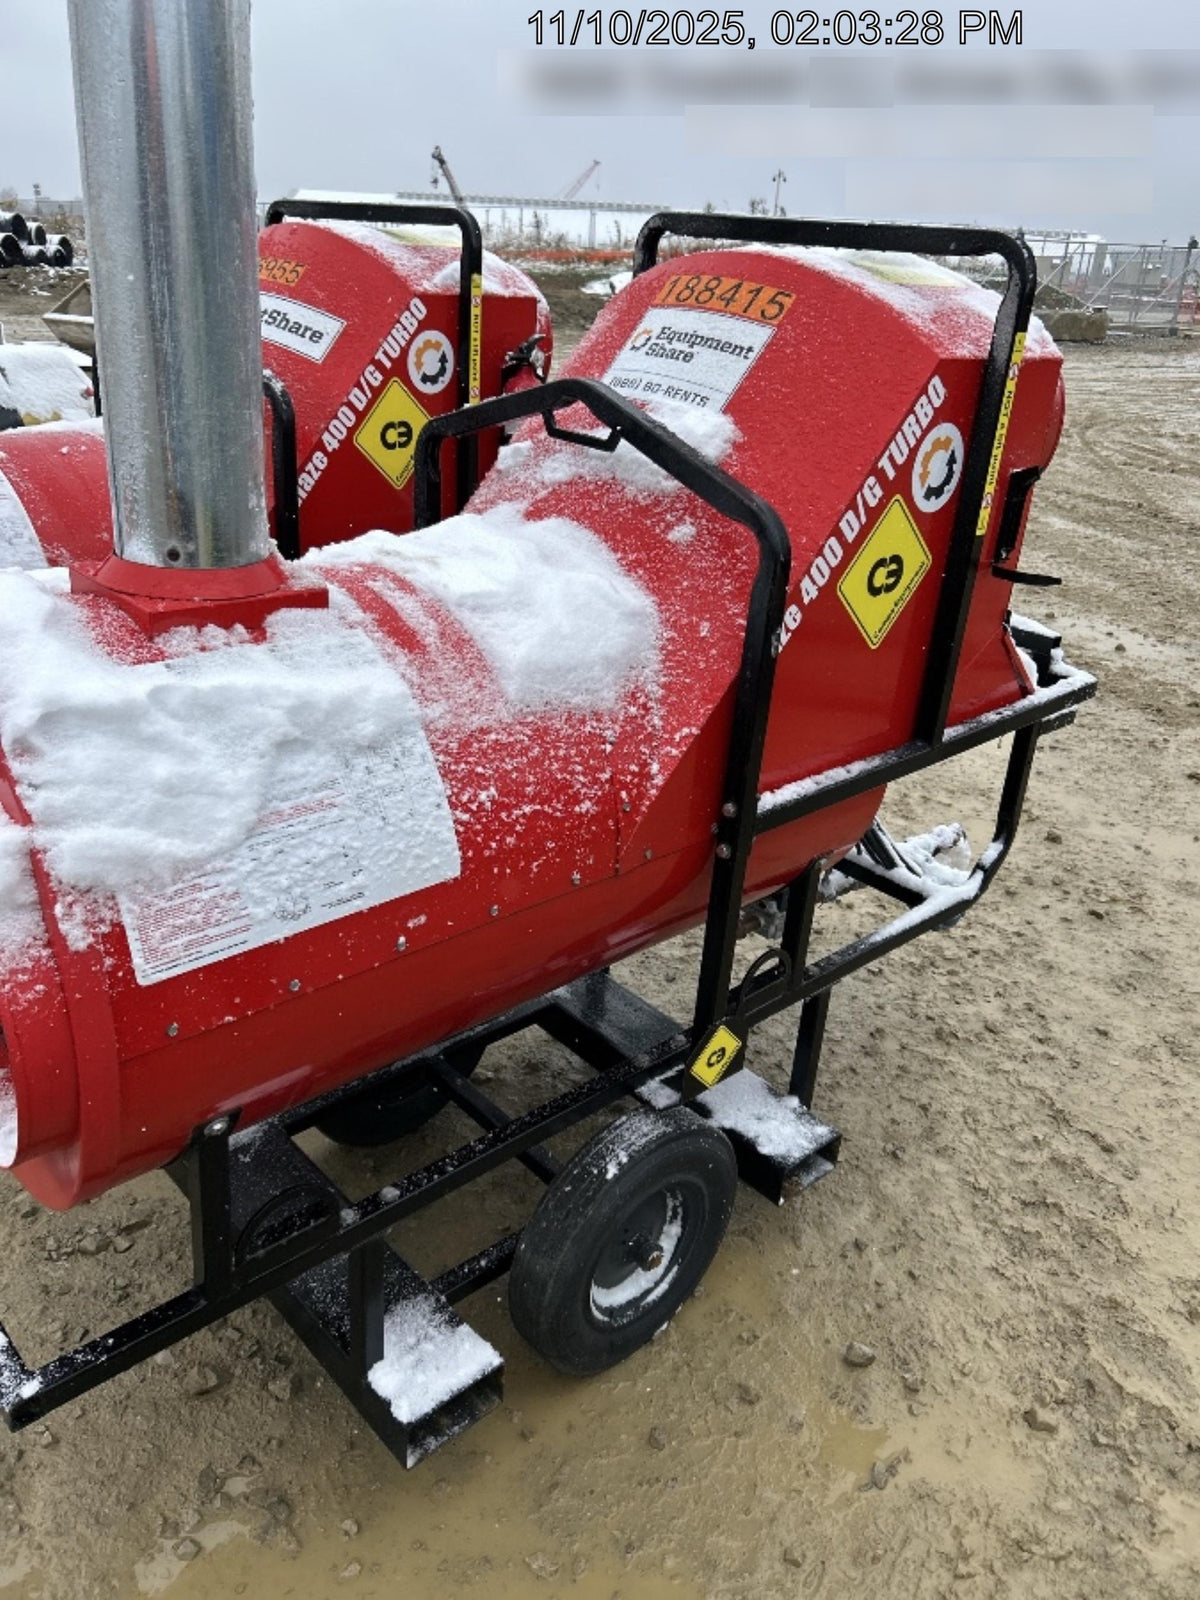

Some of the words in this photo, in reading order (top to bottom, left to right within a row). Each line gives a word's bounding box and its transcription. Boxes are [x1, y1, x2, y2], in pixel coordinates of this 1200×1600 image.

[663, 275, 792, 321] 188415
[645, 341, 694, 363] Share
[656, 326, 755, 360] Equipment
[321, 405, 356, 452] 400
[348, 364, 383, 412] D/G
[374, 297, 428, 370] TURBO
[799, 536, 844, 605] 400
[839, 475, 884, 544] D/G
[877, 374, 948, 481] TURBO
